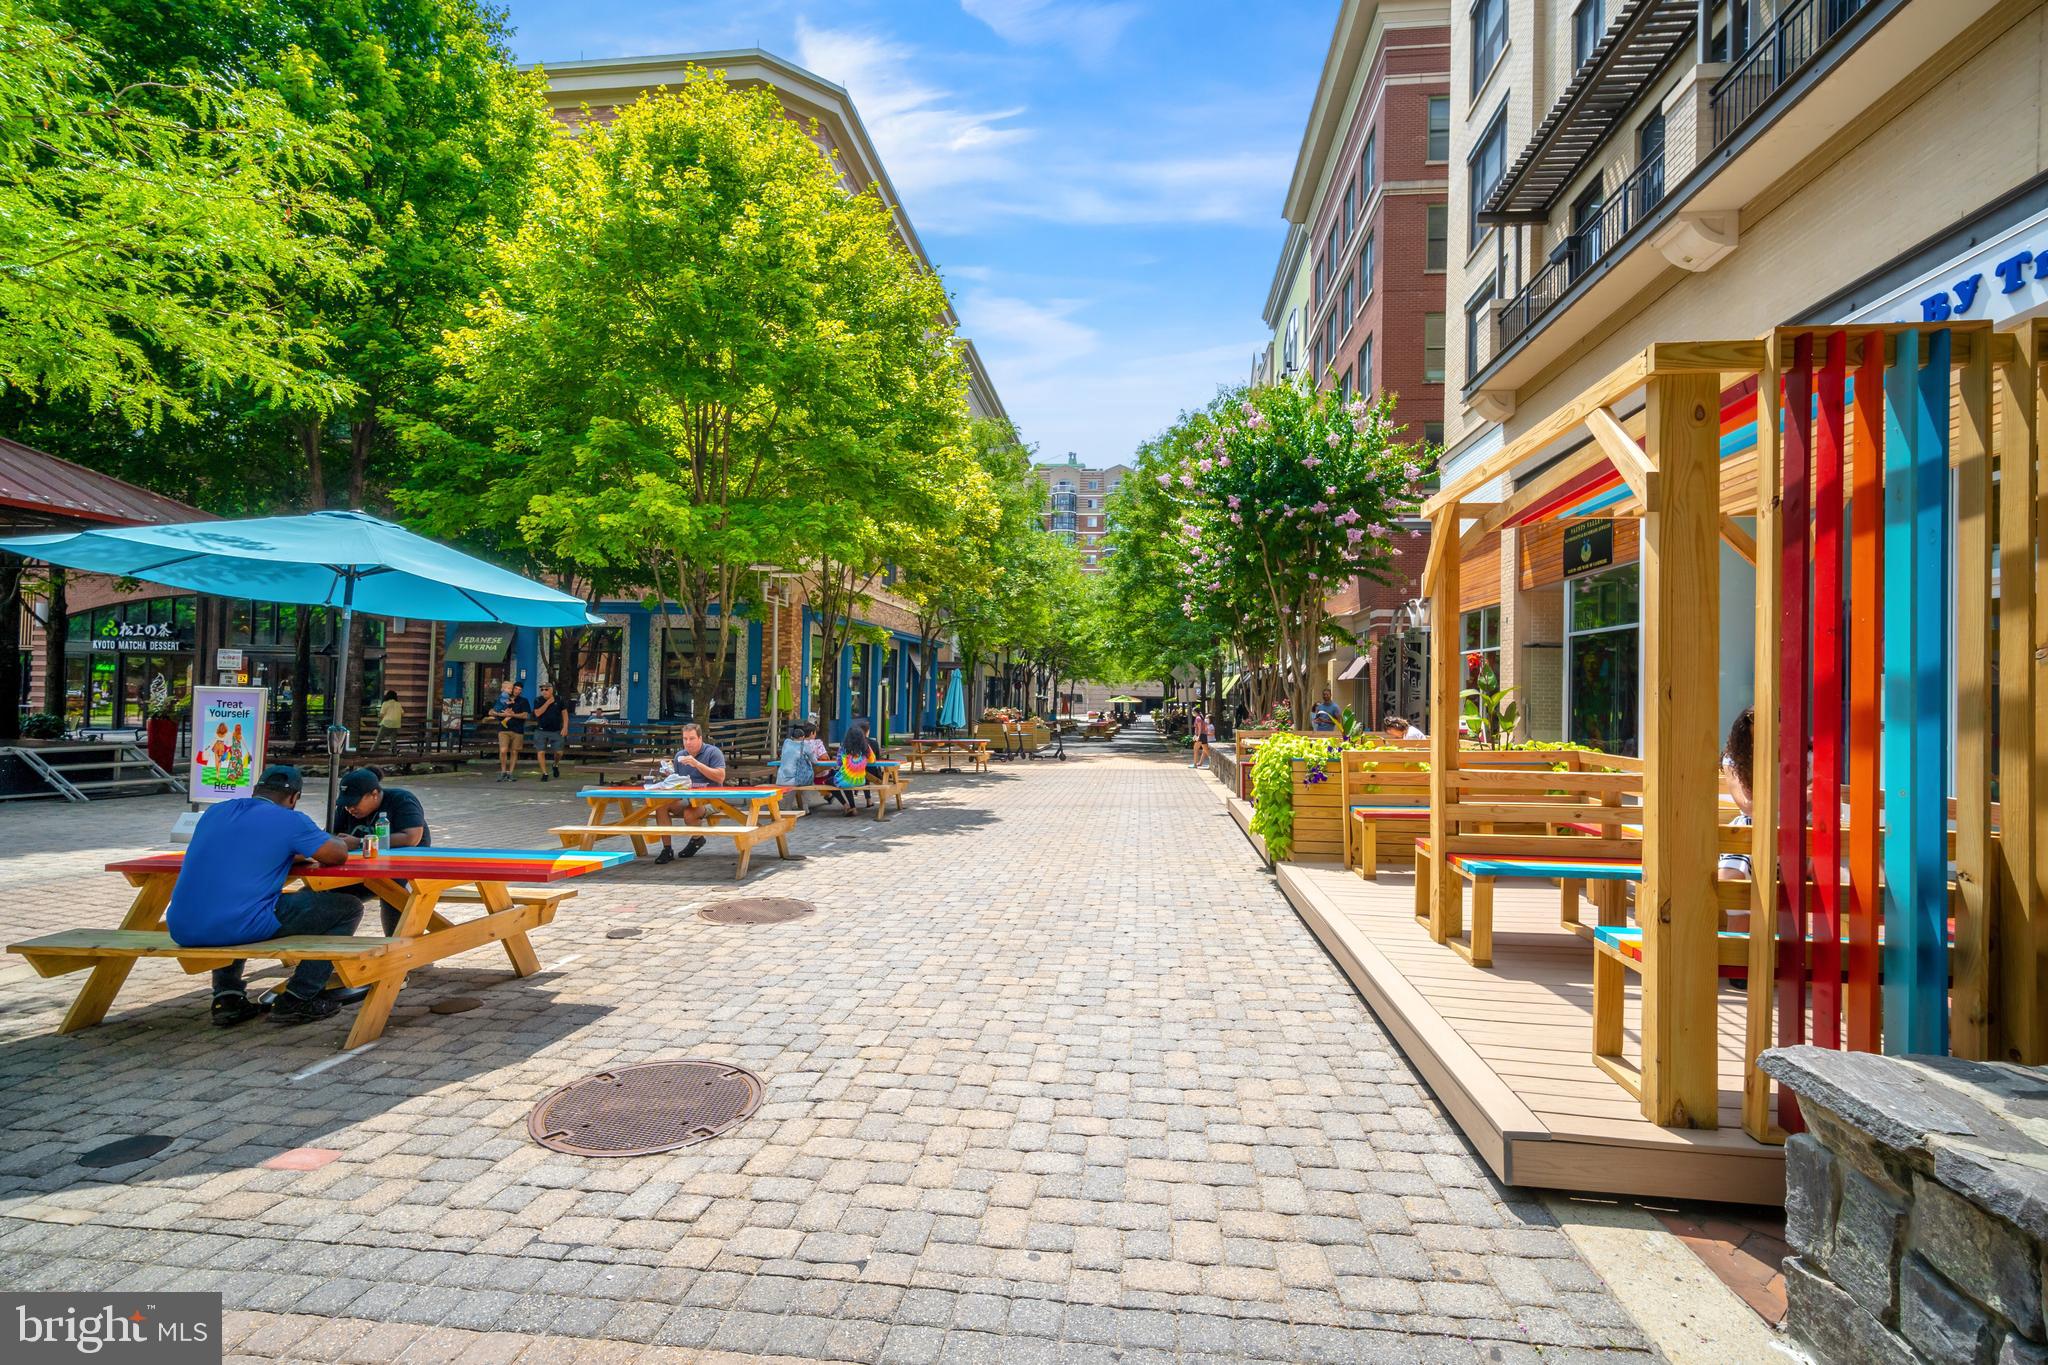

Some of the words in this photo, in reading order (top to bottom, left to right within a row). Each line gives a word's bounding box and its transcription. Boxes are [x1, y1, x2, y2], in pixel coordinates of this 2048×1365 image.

[458, 636, 503, 644] LEBANESE
[92, 640, 115, 649] KYOTO
[118, 641, 147, 650] MATCHA
[150, 641, 180, 651] DESSERT
[458, 643, 497, 651] TAVERNA
[216, 699, 243, 709] Treat
[209, 708, 250, 718] Yourself
[214, 781, 237, 791] Here
